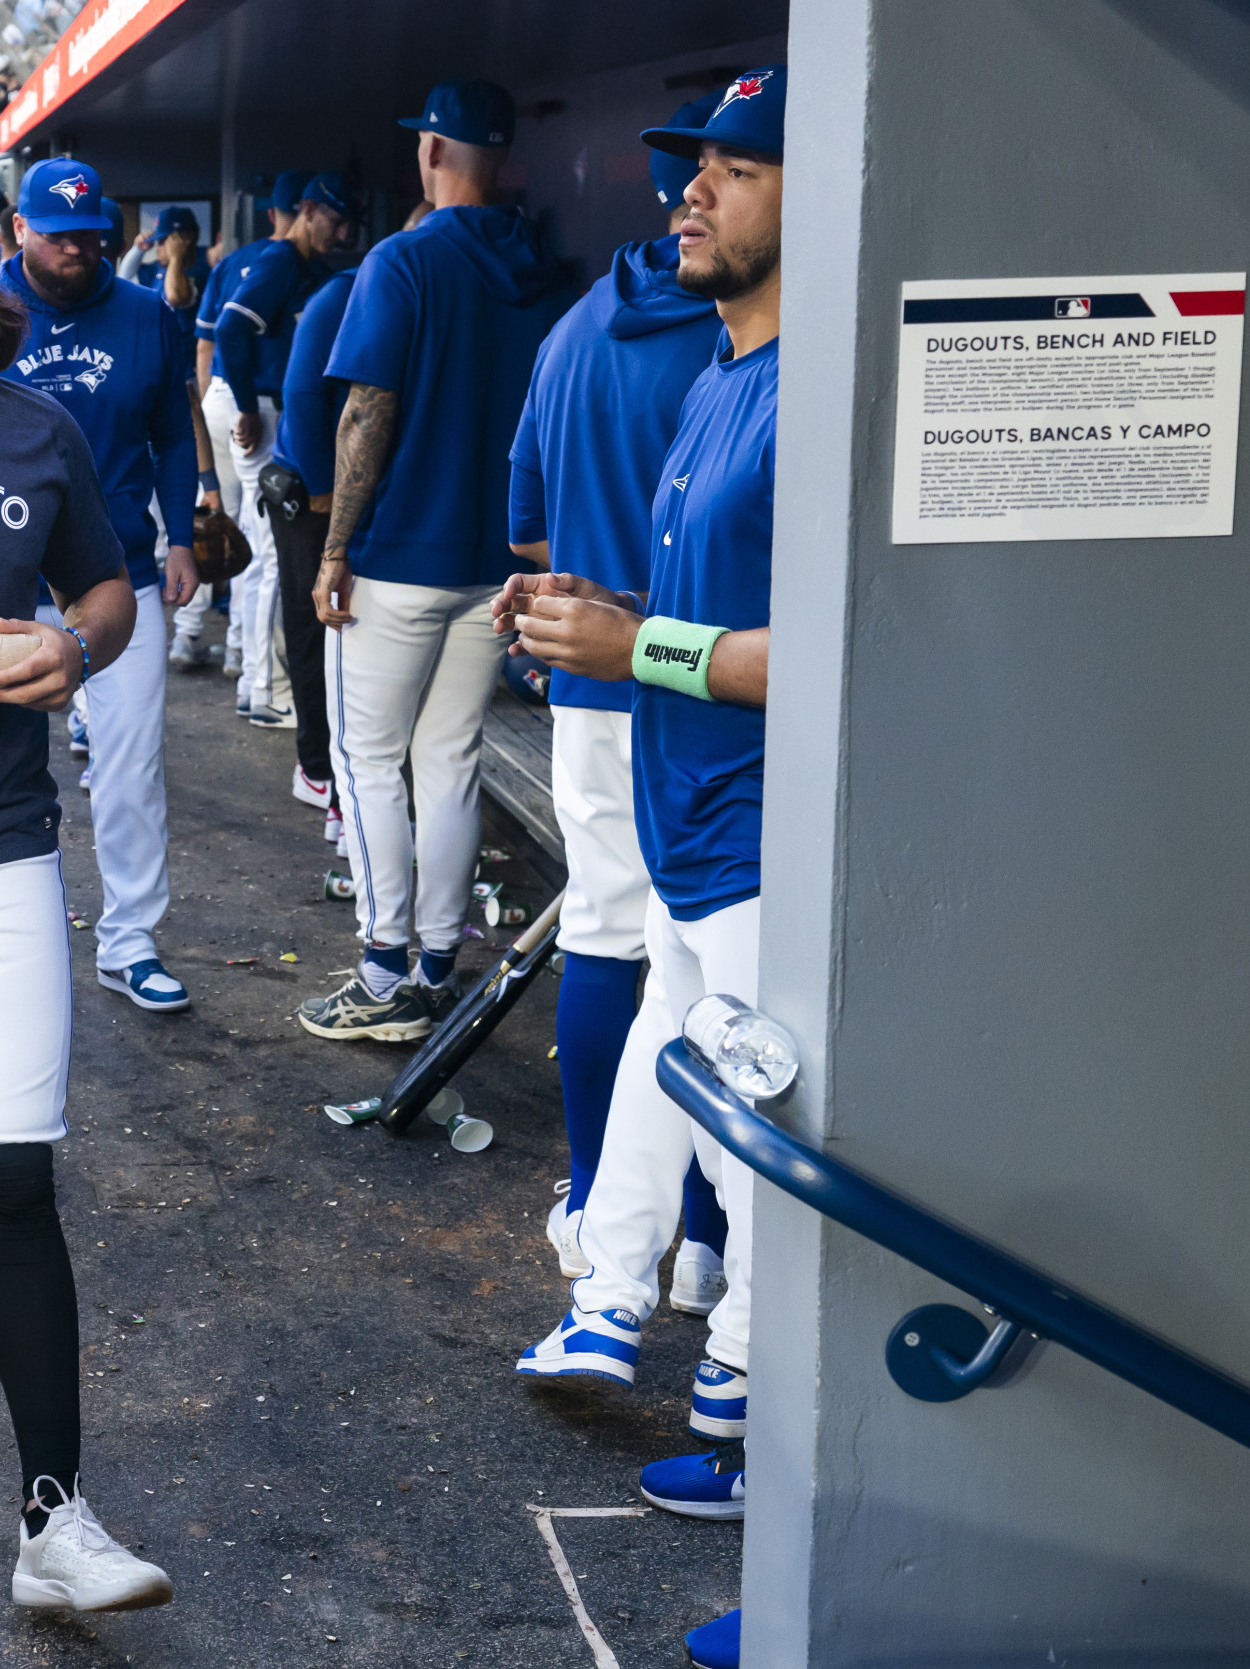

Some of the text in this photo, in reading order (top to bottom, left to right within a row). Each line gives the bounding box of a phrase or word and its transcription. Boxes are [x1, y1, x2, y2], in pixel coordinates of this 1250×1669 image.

[926, 330, 1217, 353] DUGOUTS, BENCH AND FIELD
[16, 344, 114, 377] BLUE JAYS
[924, 423, 1211, 446] DUGOUTS, BANCAS Y CAMPO
[644, 643, 703, 672] franklin
[612, 1309, 637, 1326] NIKE
[698, 1365, 720, 1379] NIKE
